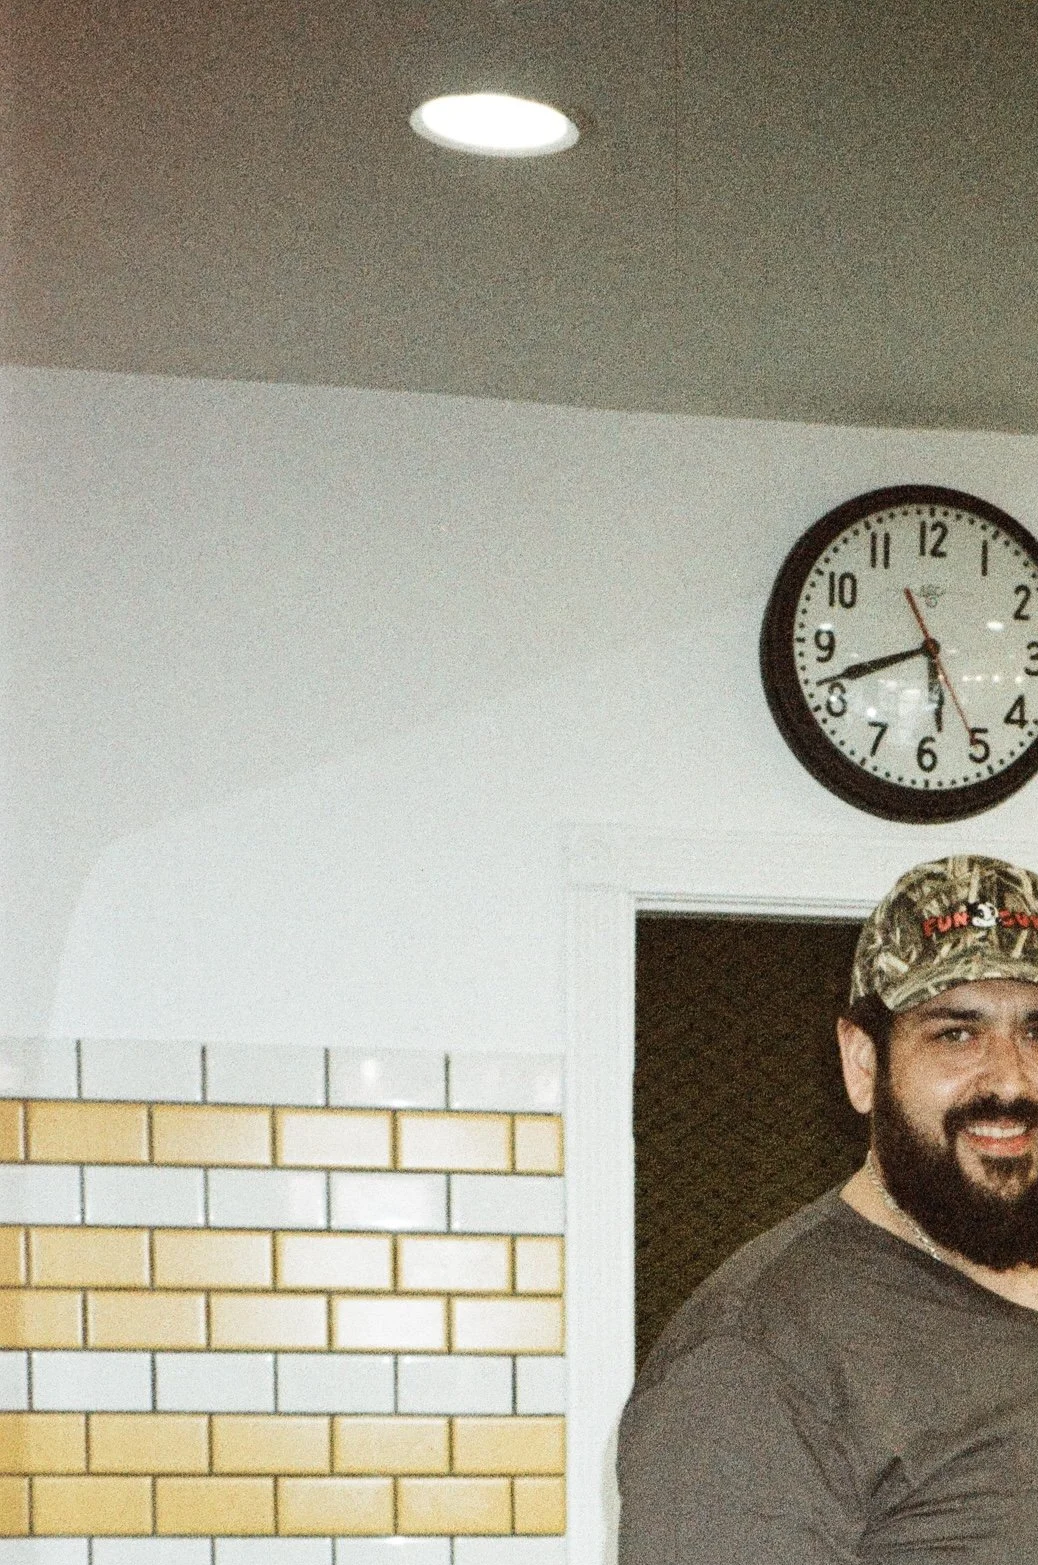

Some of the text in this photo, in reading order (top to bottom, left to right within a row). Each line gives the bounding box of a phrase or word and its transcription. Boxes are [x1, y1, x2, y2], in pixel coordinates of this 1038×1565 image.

[870, 531, 890, 569] 11
[919, 520, 949, 558] 12
[980, 539, 989, 577] 1
[828, 571, 857, 609] 10
[1013, 585, 1031, 621] 2
[814, 628, 836, 663] 9
[825, 681, 848, 718] 8
[1003, 694, 1028, 728] 4
[868, 721, 888, 757] 7
[916, 736, 938, 773] 6
[968, 727, 990, 763] 5
